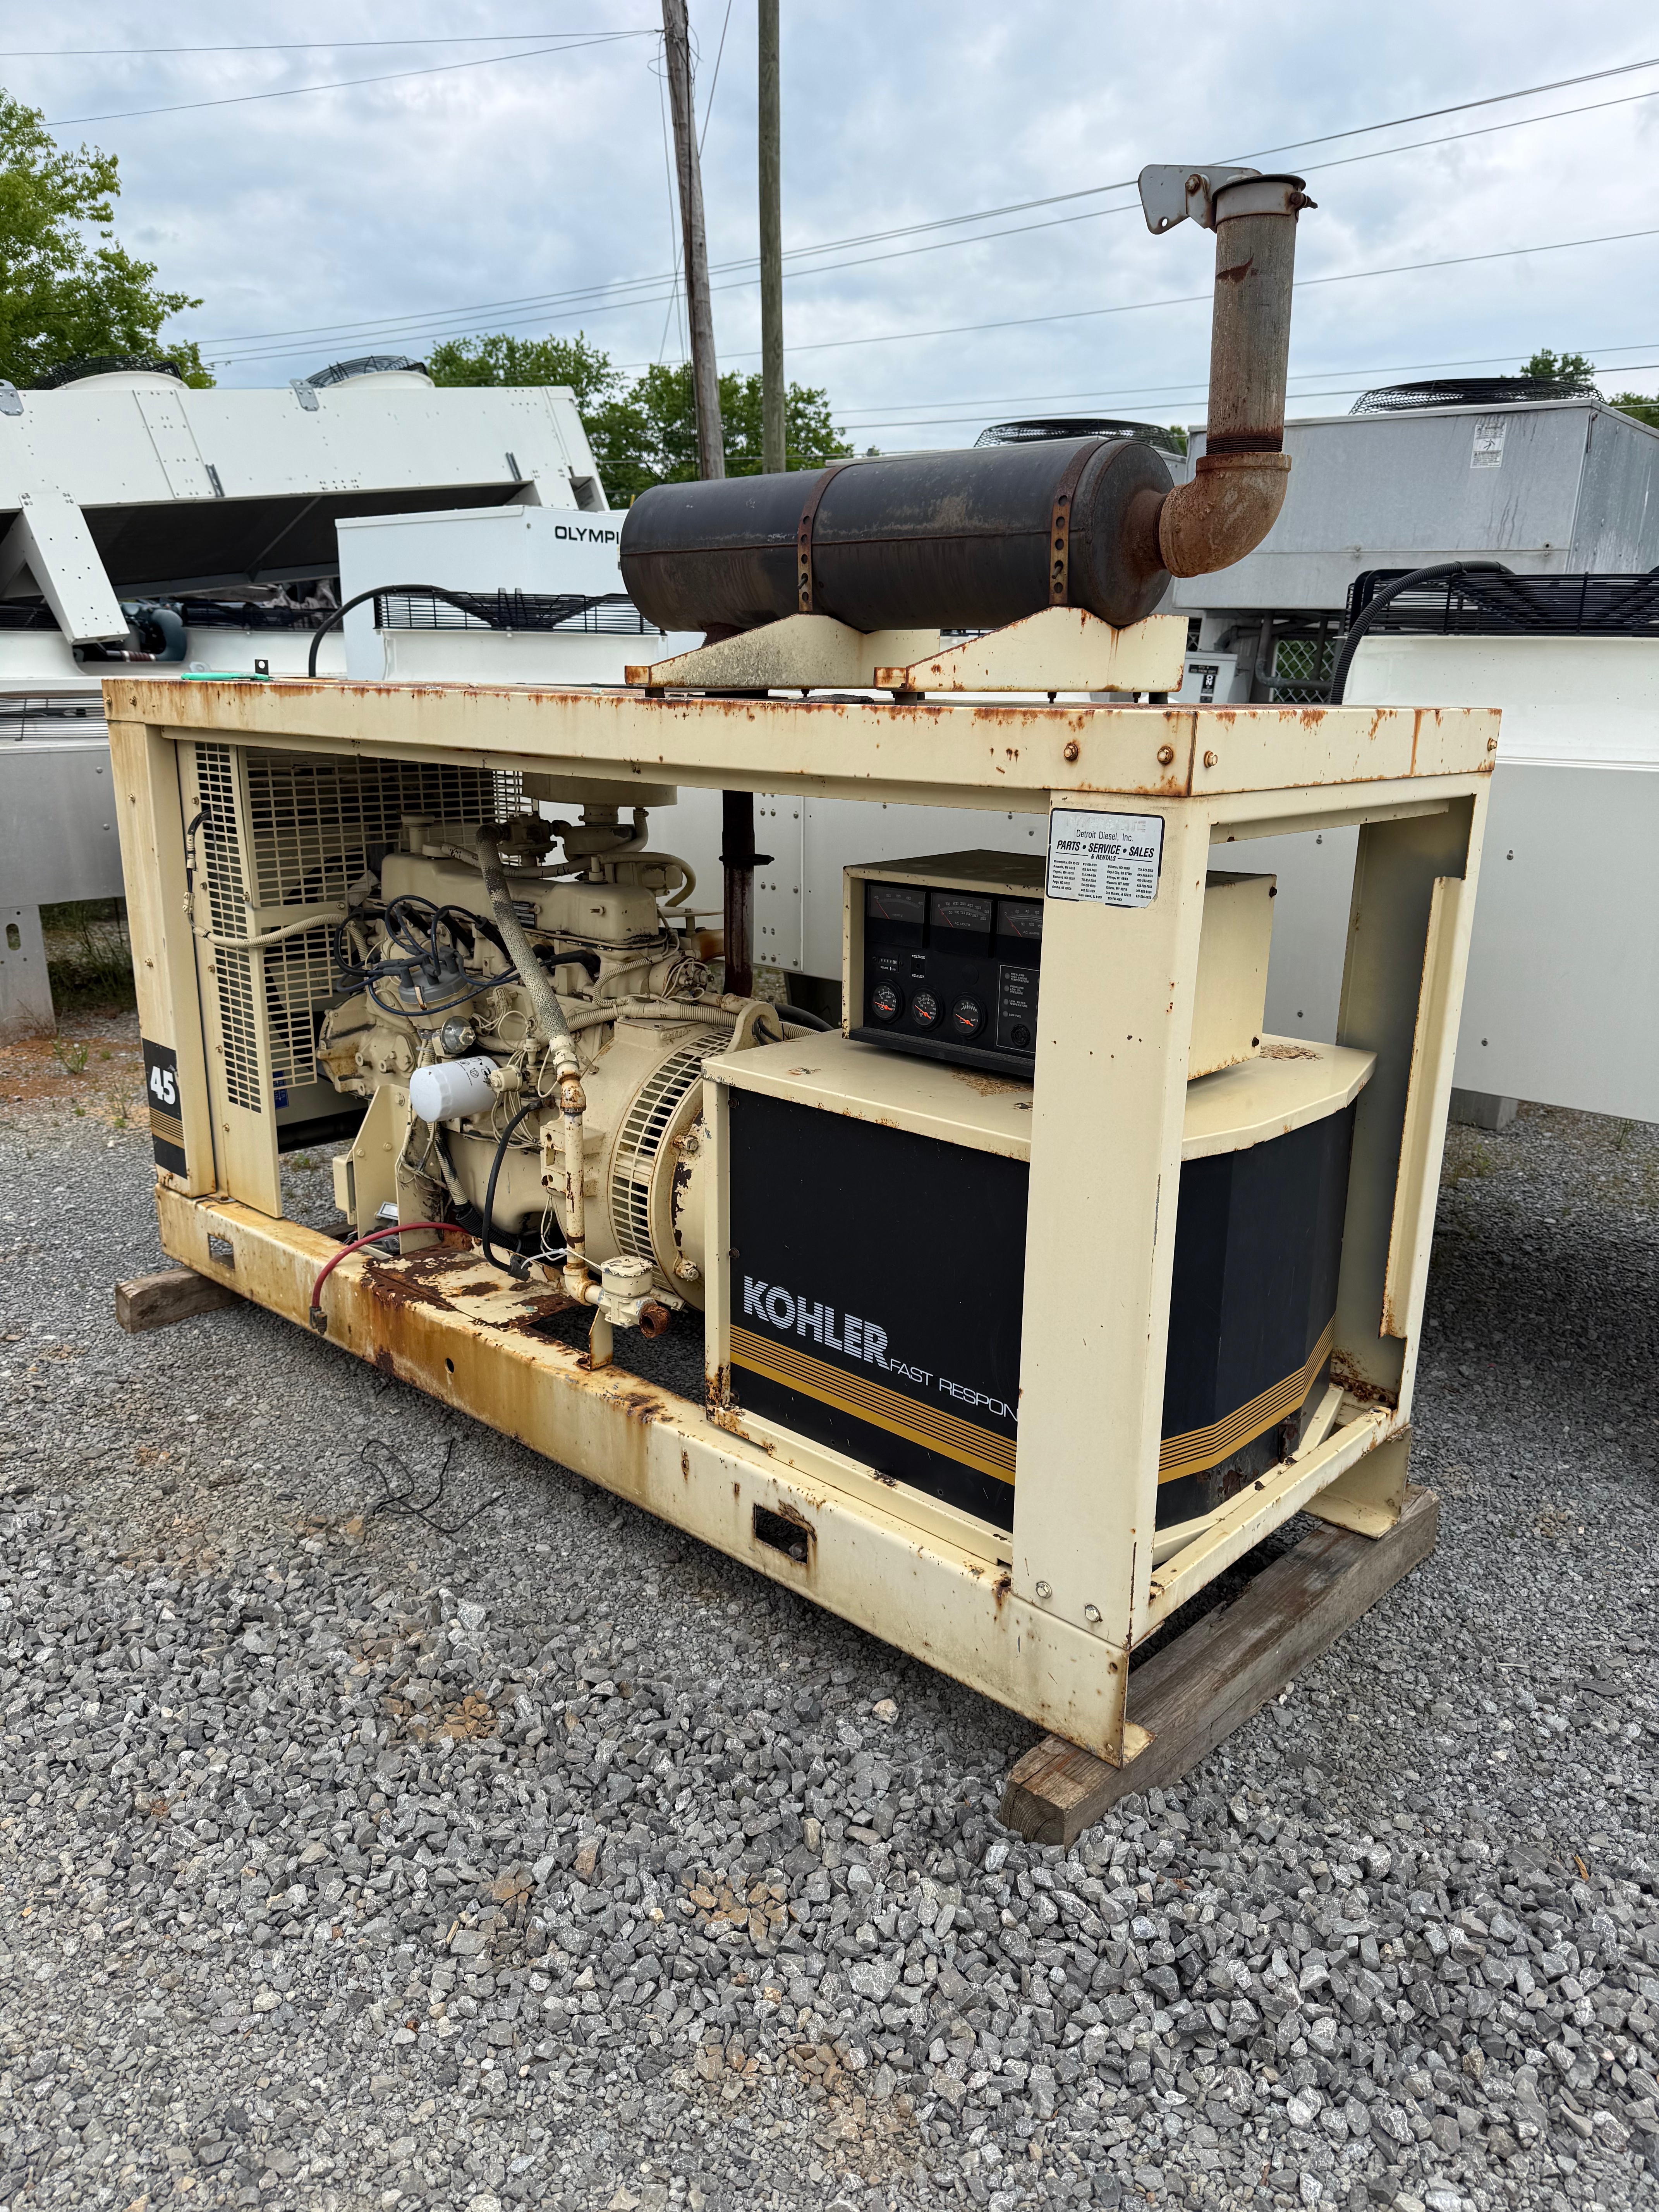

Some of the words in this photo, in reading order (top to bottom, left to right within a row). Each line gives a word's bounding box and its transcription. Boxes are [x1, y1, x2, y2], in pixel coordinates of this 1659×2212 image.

[555, 526, 619, 544] OLYMPI
[1205, 675, 1213, 685] ON
[1077, 830, 1096, 839] Detroit
[1099, 831, 1119, 842] Diesel,
[1123, 833, 1133, 842] Inc.
[1056, 840, 1080, 851] PARTS
[1088, 843, 1121, 855] SERVICE
[1129, 846, 1154, 858] SALES
[150, 1066, 175, 1104] 45
[744, 1275, 891, 1370] KOHLER
[890, 1358, 933, 1386] FAST
[939, 1377, 1018, 1422] RESPON
